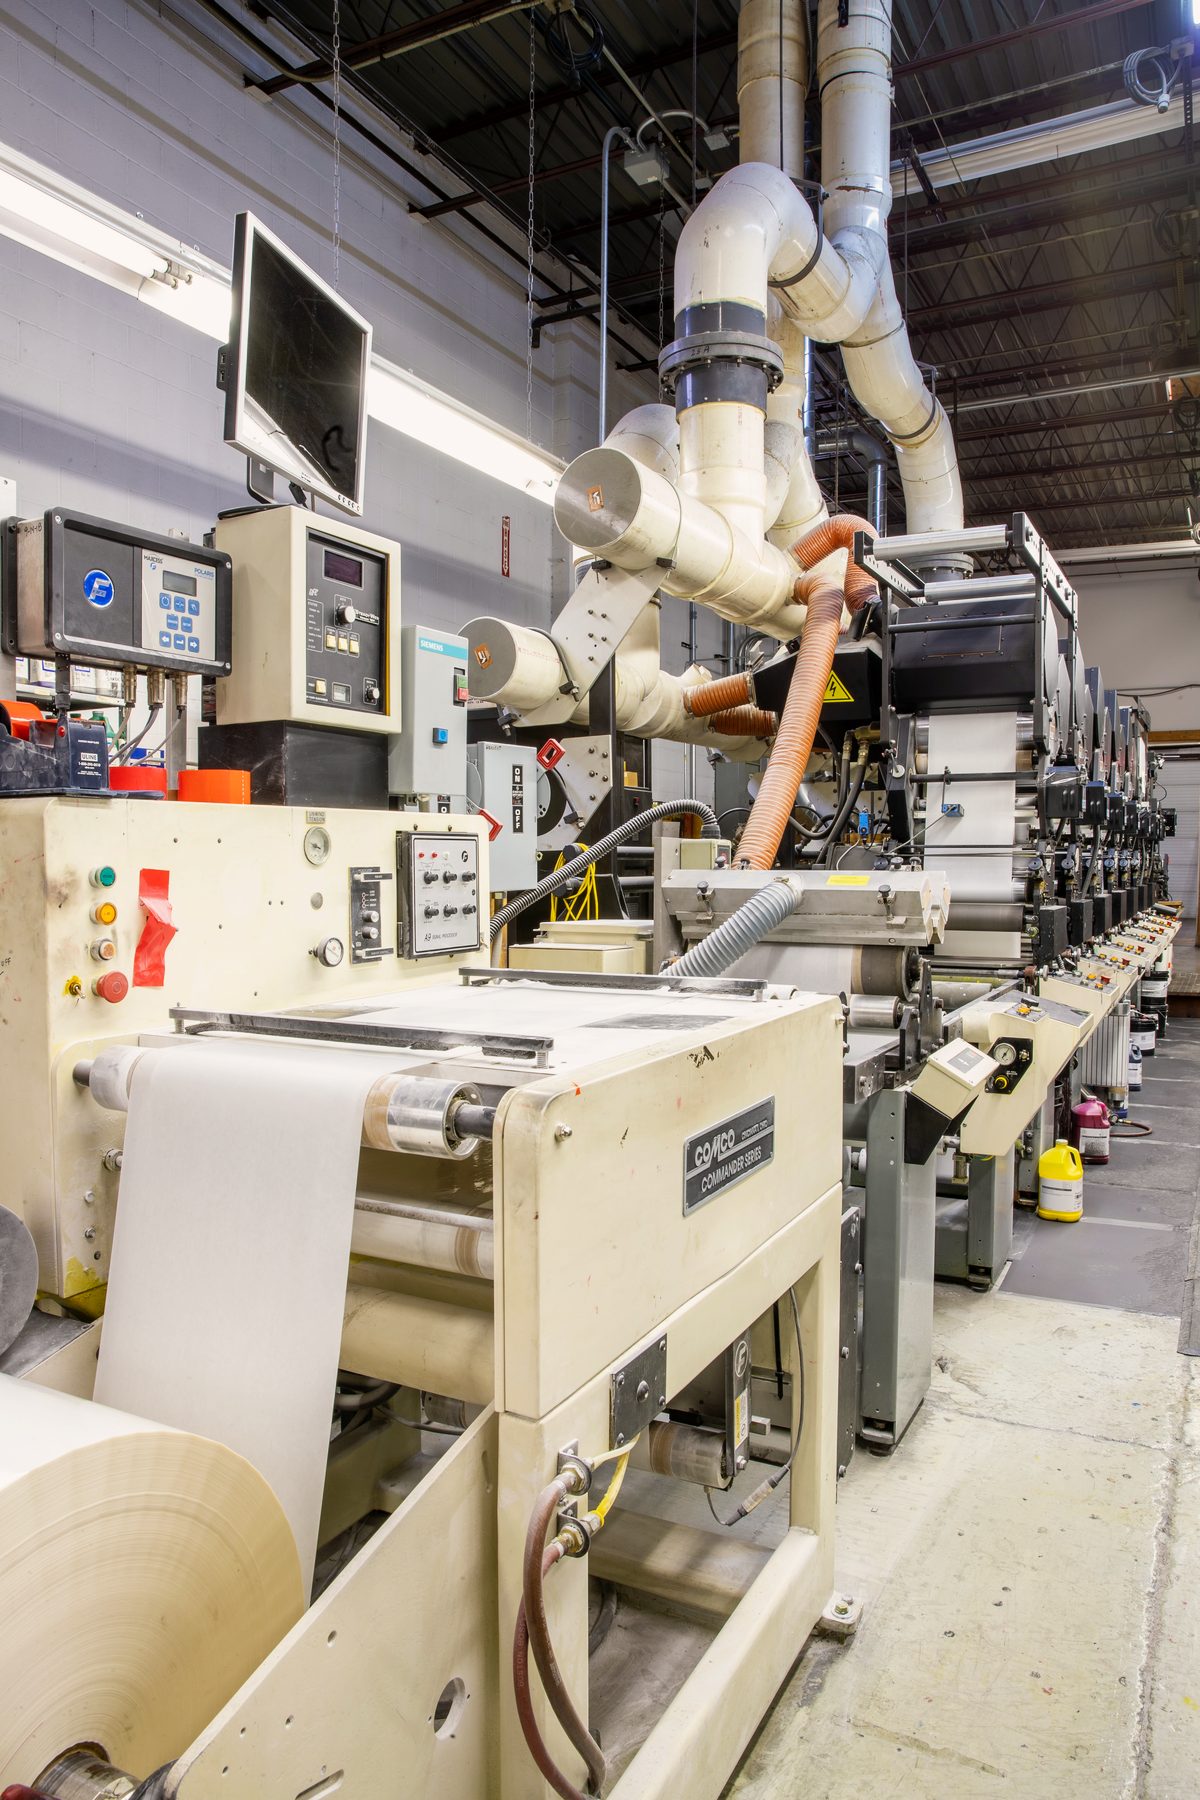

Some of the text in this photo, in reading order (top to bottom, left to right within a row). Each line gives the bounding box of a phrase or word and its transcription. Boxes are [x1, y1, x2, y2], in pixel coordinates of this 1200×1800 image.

[420, 639, 444, 652] SIEMENS
[81, 753, 98, 761] ULINE
[514, 767, 521, 783] ON
[695, 1129, 735, 1166] COMCO
[701, 1145, 762, 1192] COMMANDER SERIES
